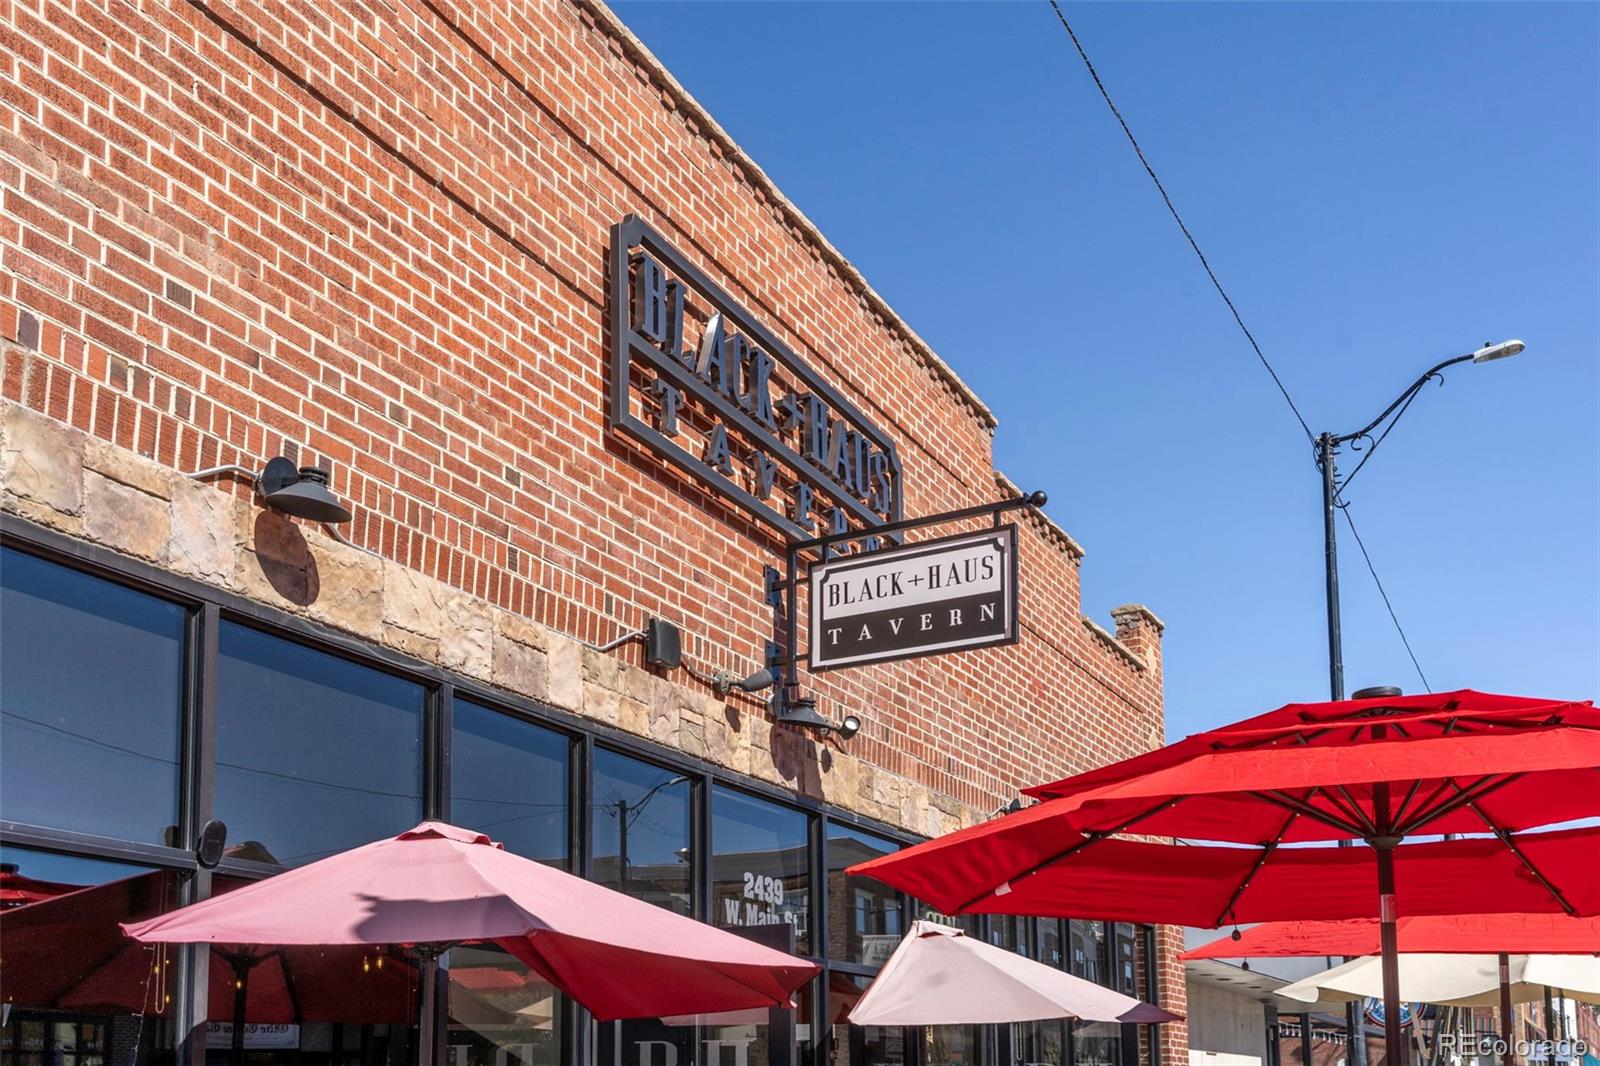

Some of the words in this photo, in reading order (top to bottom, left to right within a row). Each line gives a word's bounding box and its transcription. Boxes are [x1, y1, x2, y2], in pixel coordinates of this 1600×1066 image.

[631, 252, 890, 514] BLACK+HAUS
[828, 555, 994, 608] BLACK+HAUS
[828, 602, 996, 646] TAVERN
[743, 871, 784, 906] 2439
[725, 898, 743, 927] W.
[746, 902, 780, 927] Main
